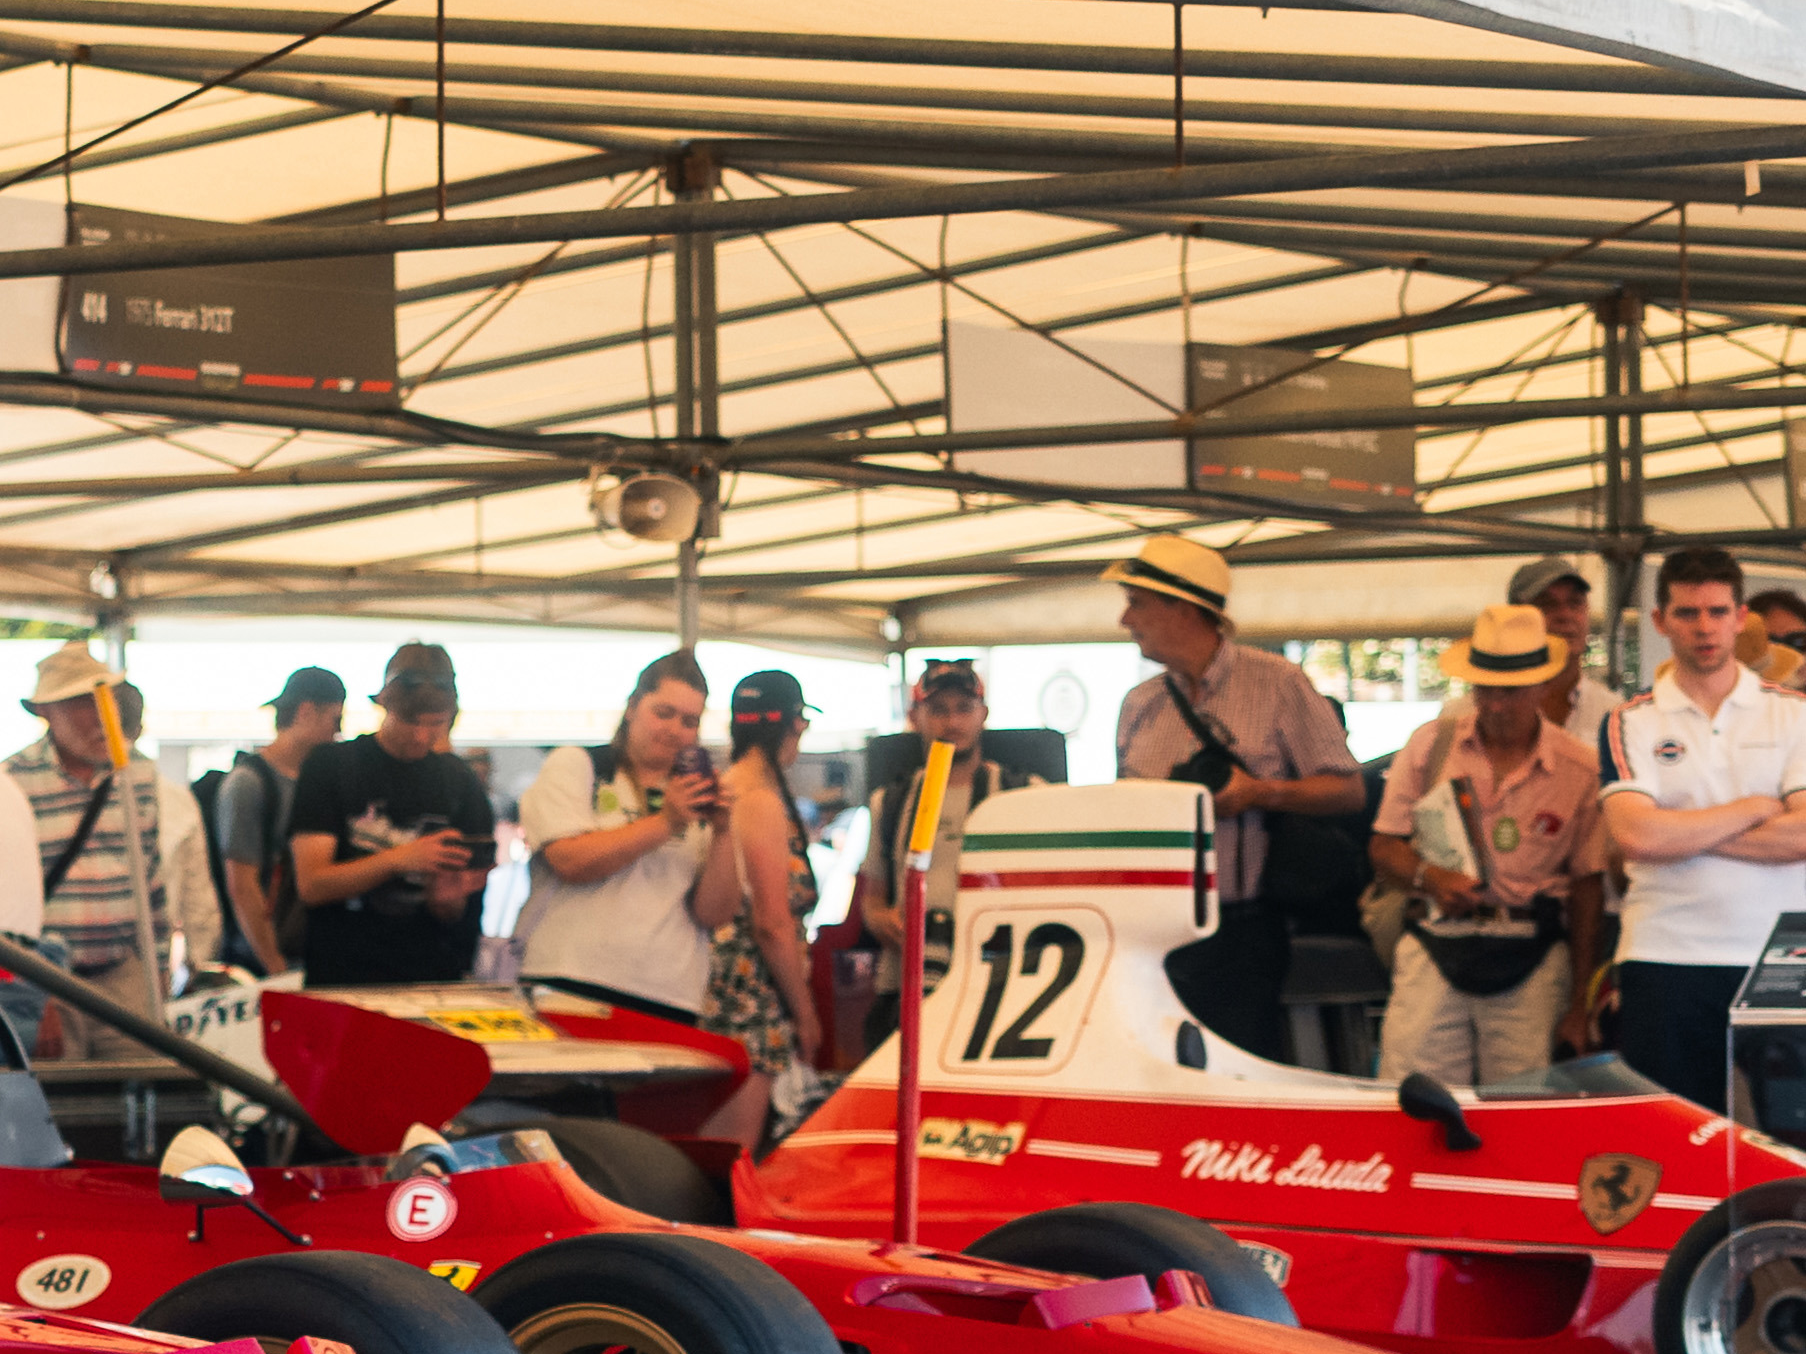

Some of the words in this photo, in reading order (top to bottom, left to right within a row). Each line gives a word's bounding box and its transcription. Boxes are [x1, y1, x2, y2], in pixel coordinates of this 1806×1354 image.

[962, 923, 1085, 1060] 12
[950, 1123, 1014, 1157] Agip
[1183, 1137, 1279, 1184] Niki
[1274, 1144, 1393, 1193] Lauda
[409, 1192, 433, 1228] E
[34, 1268, 91, 1296] 481
